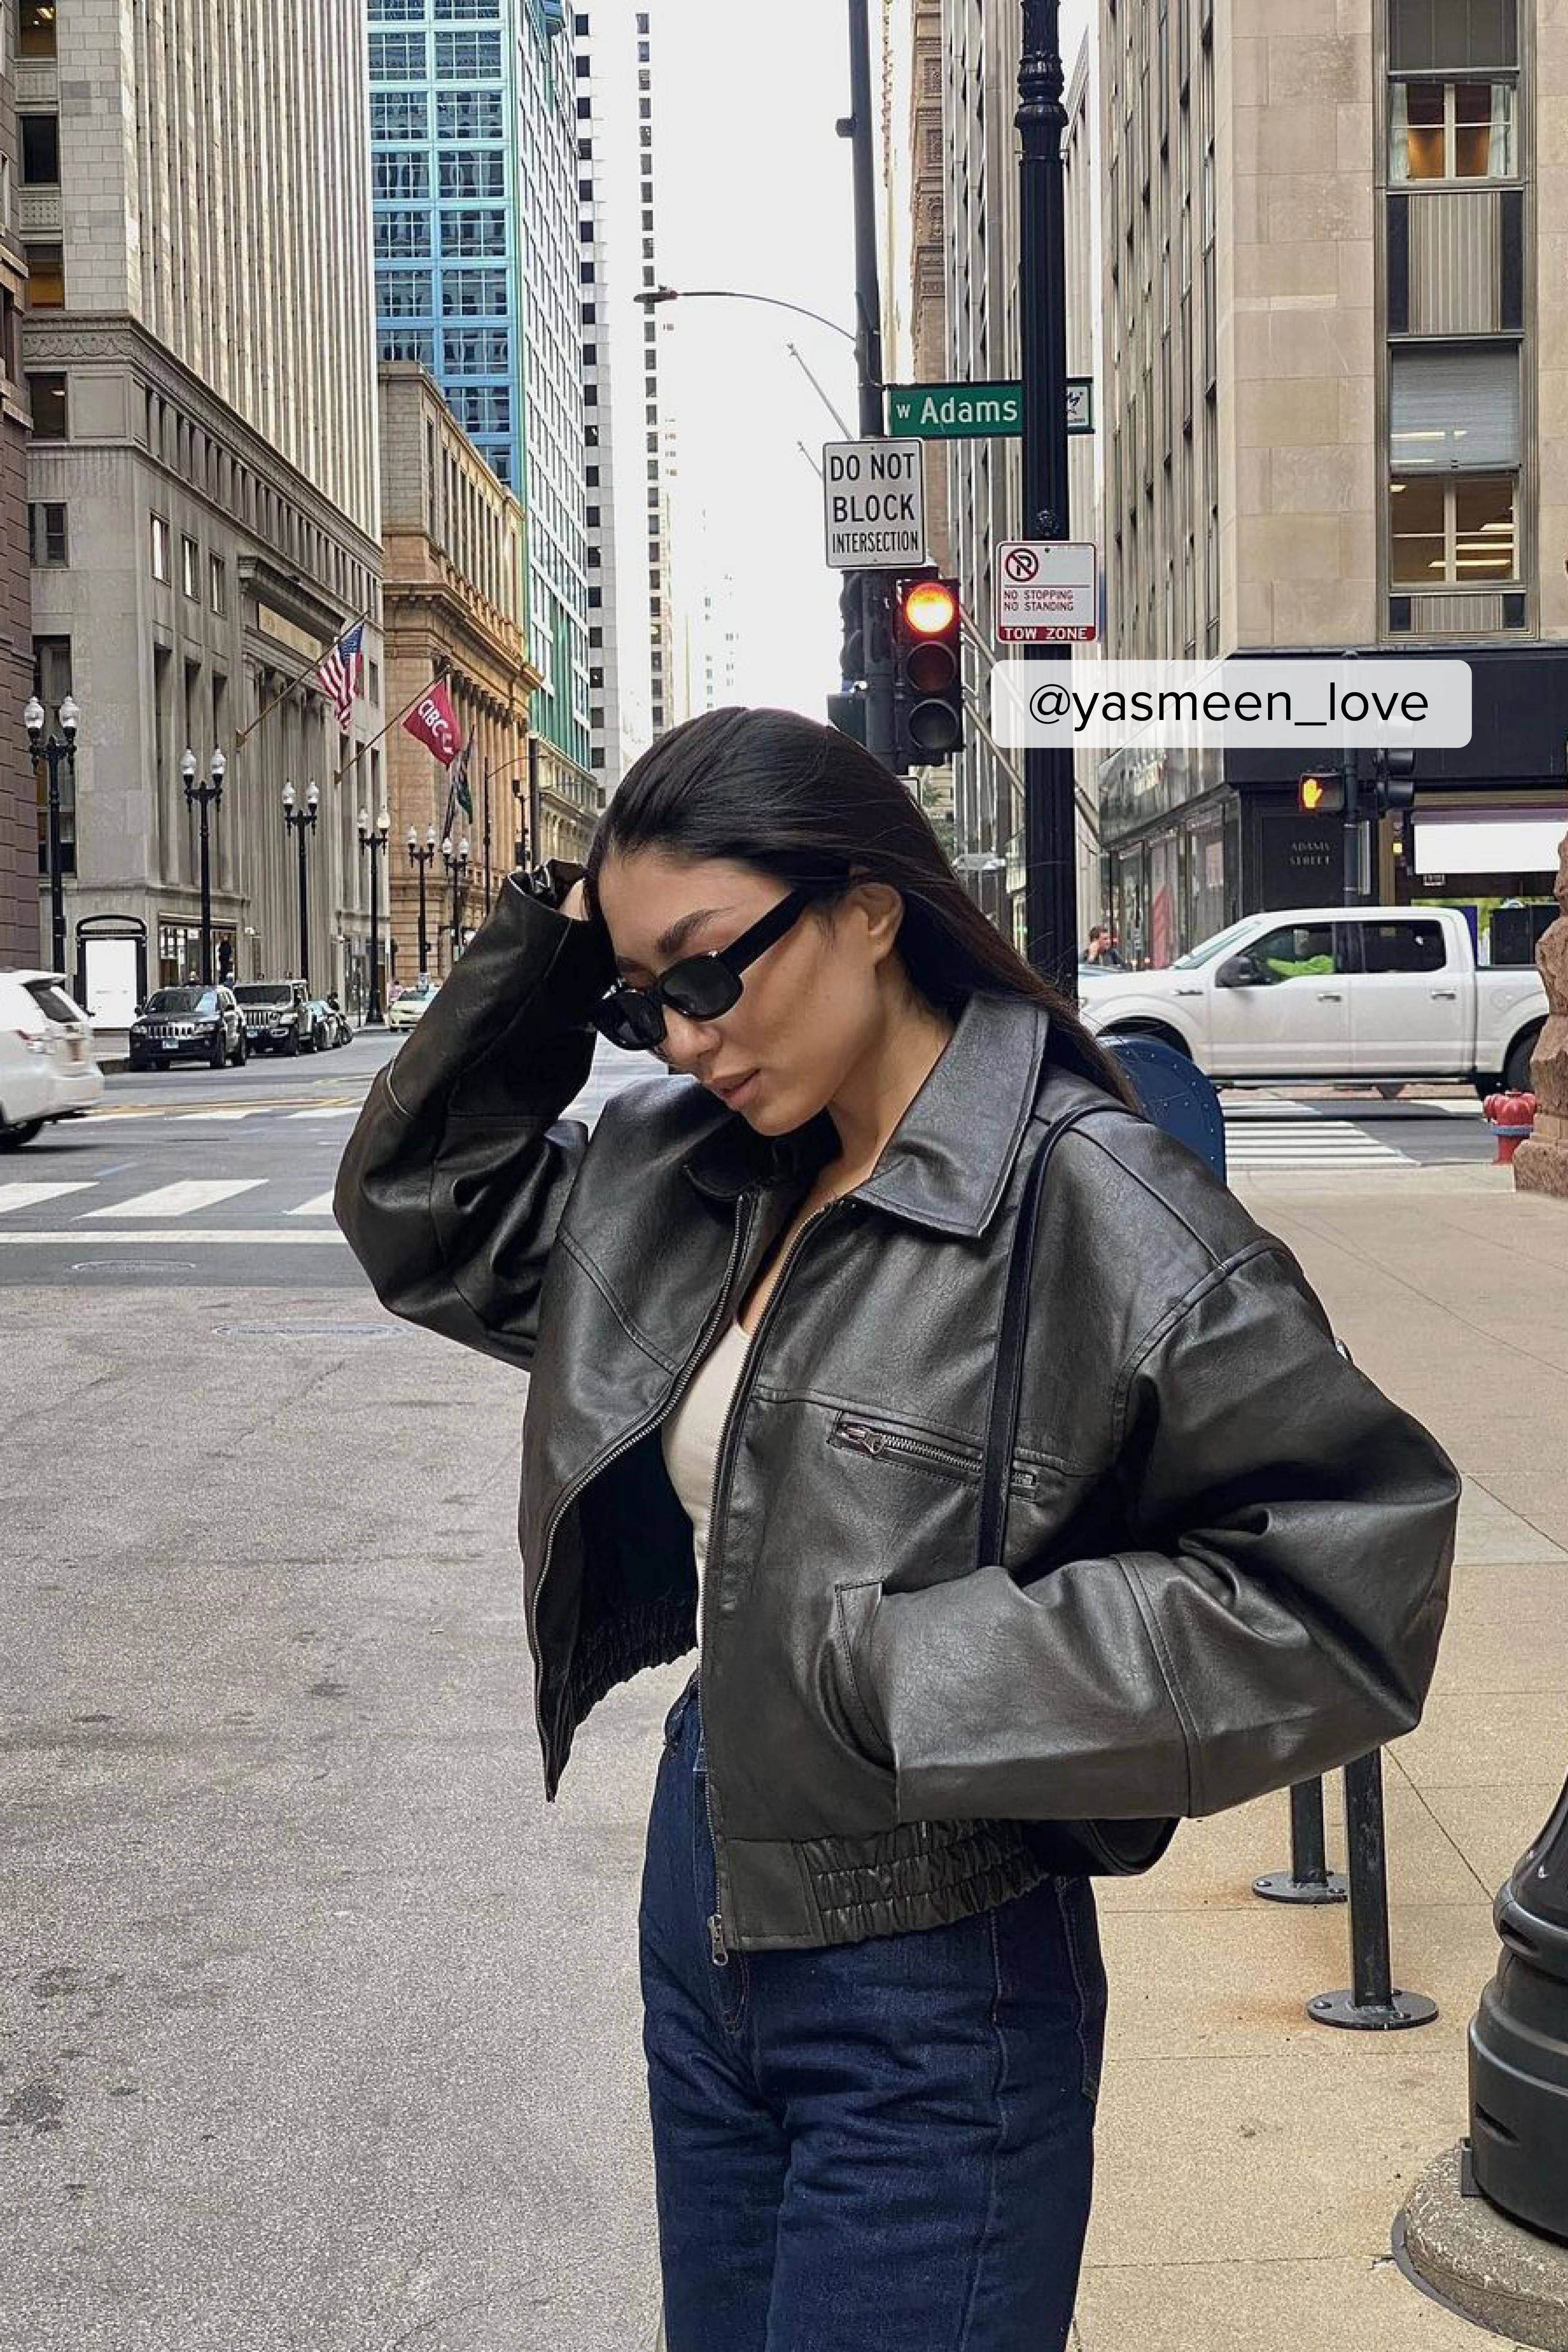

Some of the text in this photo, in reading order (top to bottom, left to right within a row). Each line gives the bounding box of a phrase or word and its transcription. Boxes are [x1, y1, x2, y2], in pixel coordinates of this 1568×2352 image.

[920, 397, 1017, 424] Adams
[831, 453, 915, 481] DO NOT
[833, 493, 915, 523] BLOCK
[832, 530, 918, 554] INTERSECTION
[1004, 589, 1073, 599] NO STOPPING
[1004, 602, 1073, 611] NO STANDING
[1004, 628, 1087, 639] TOW ZONE
[418, 699, 448, 737] CIBC
